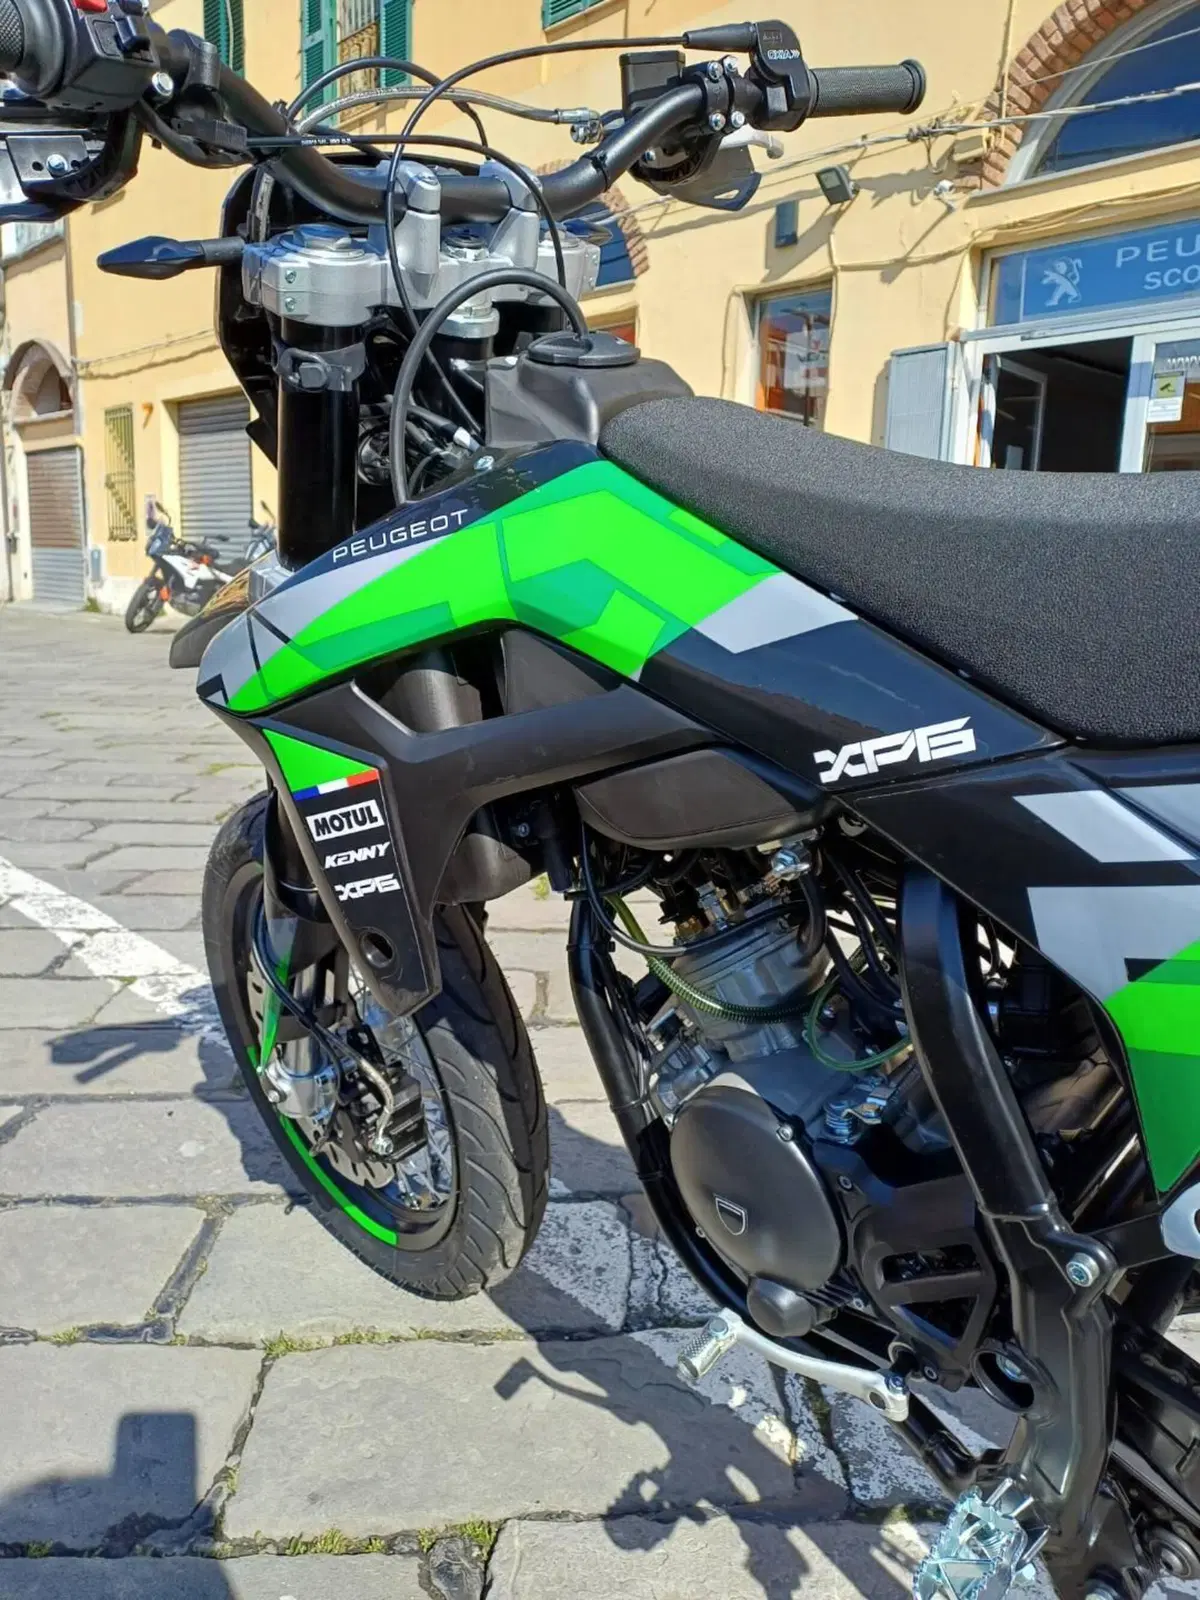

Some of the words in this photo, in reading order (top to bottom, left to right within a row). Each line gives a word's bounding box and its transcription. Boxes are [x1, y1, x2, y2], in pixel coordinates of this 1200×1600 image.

[1116, 234, 1200, 268] PEU
[1143, 264, 1200, 290] SCO
[332, 508, 468, 563] PEUGEOT
[313, 805, 379, 838] MOTUL
[324, 841, 391, 869] KENNY
